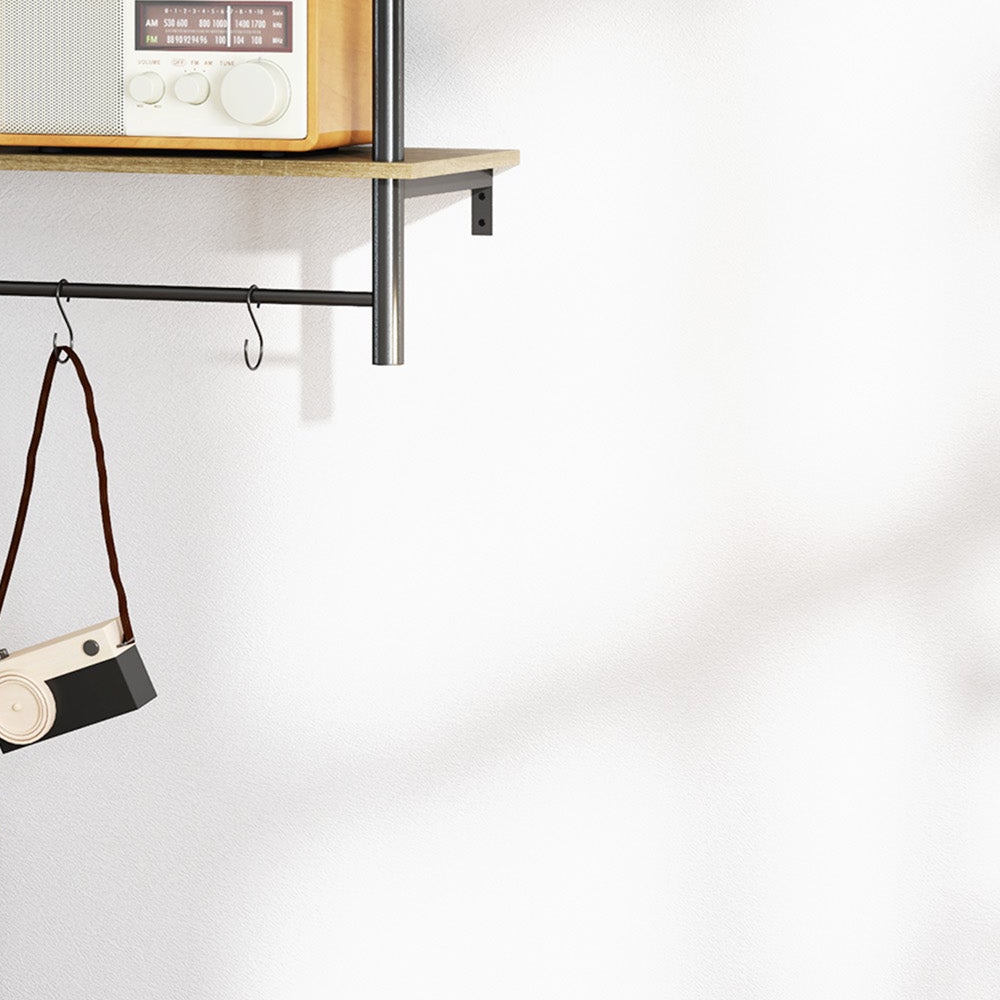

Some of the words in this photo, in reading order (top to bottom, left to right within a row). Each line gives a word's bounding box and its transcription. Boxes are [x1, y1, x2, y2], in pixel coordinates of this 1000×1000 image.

[145, 18, 159, 27] AM
[176, 18, 188, 27] 600
[235, 19, 250, 28] 1400
[251, 19, 266, 28] 1700
[145, 35, 158, 43] FM
[215, 35, 226, 44] 100
[233, 35, 244, 44] 104
